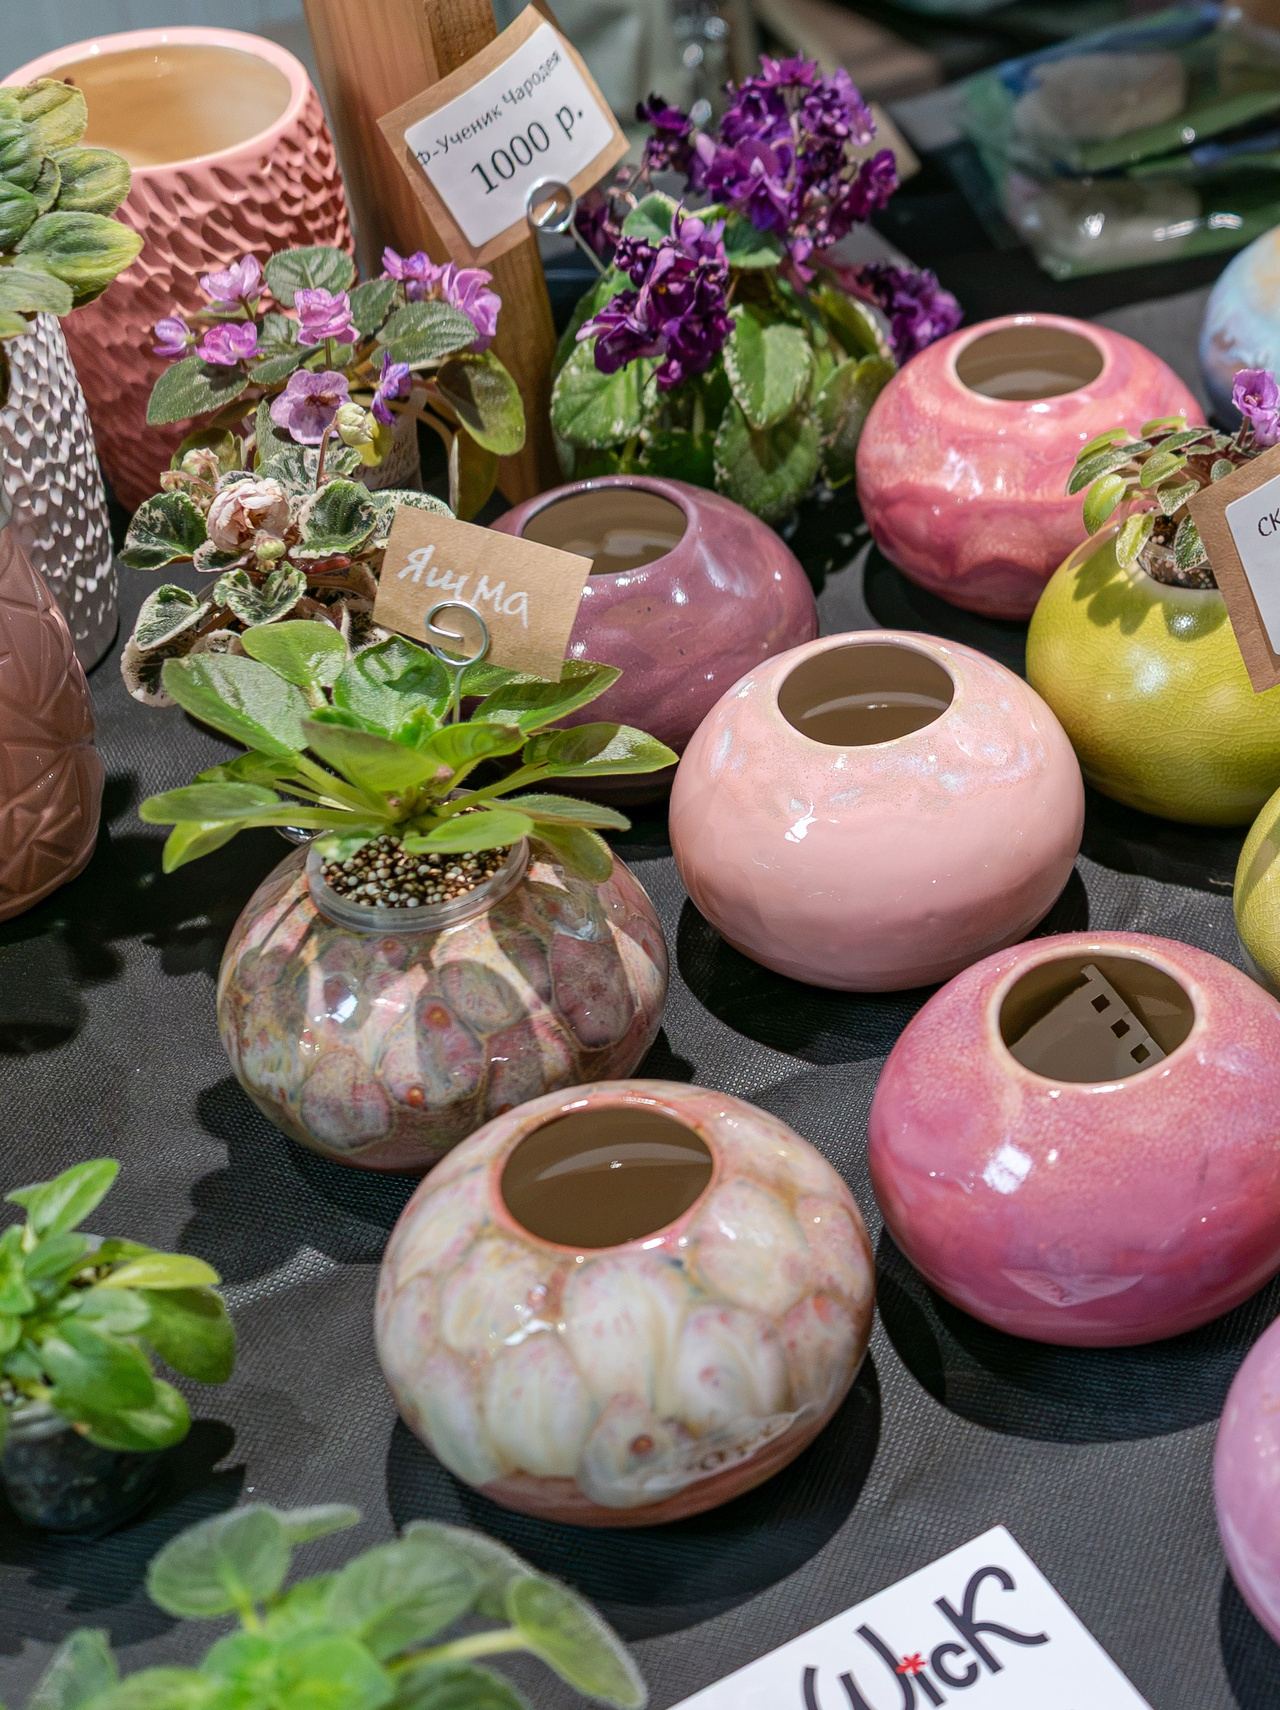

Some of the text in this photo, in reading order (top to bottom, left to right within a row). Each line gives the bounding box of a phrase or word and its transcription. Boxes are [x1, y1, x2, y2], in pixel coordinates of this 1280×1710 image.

[501, 50, 561, 105] Чародея
[470, 105, 584, 195] 1000 р.
